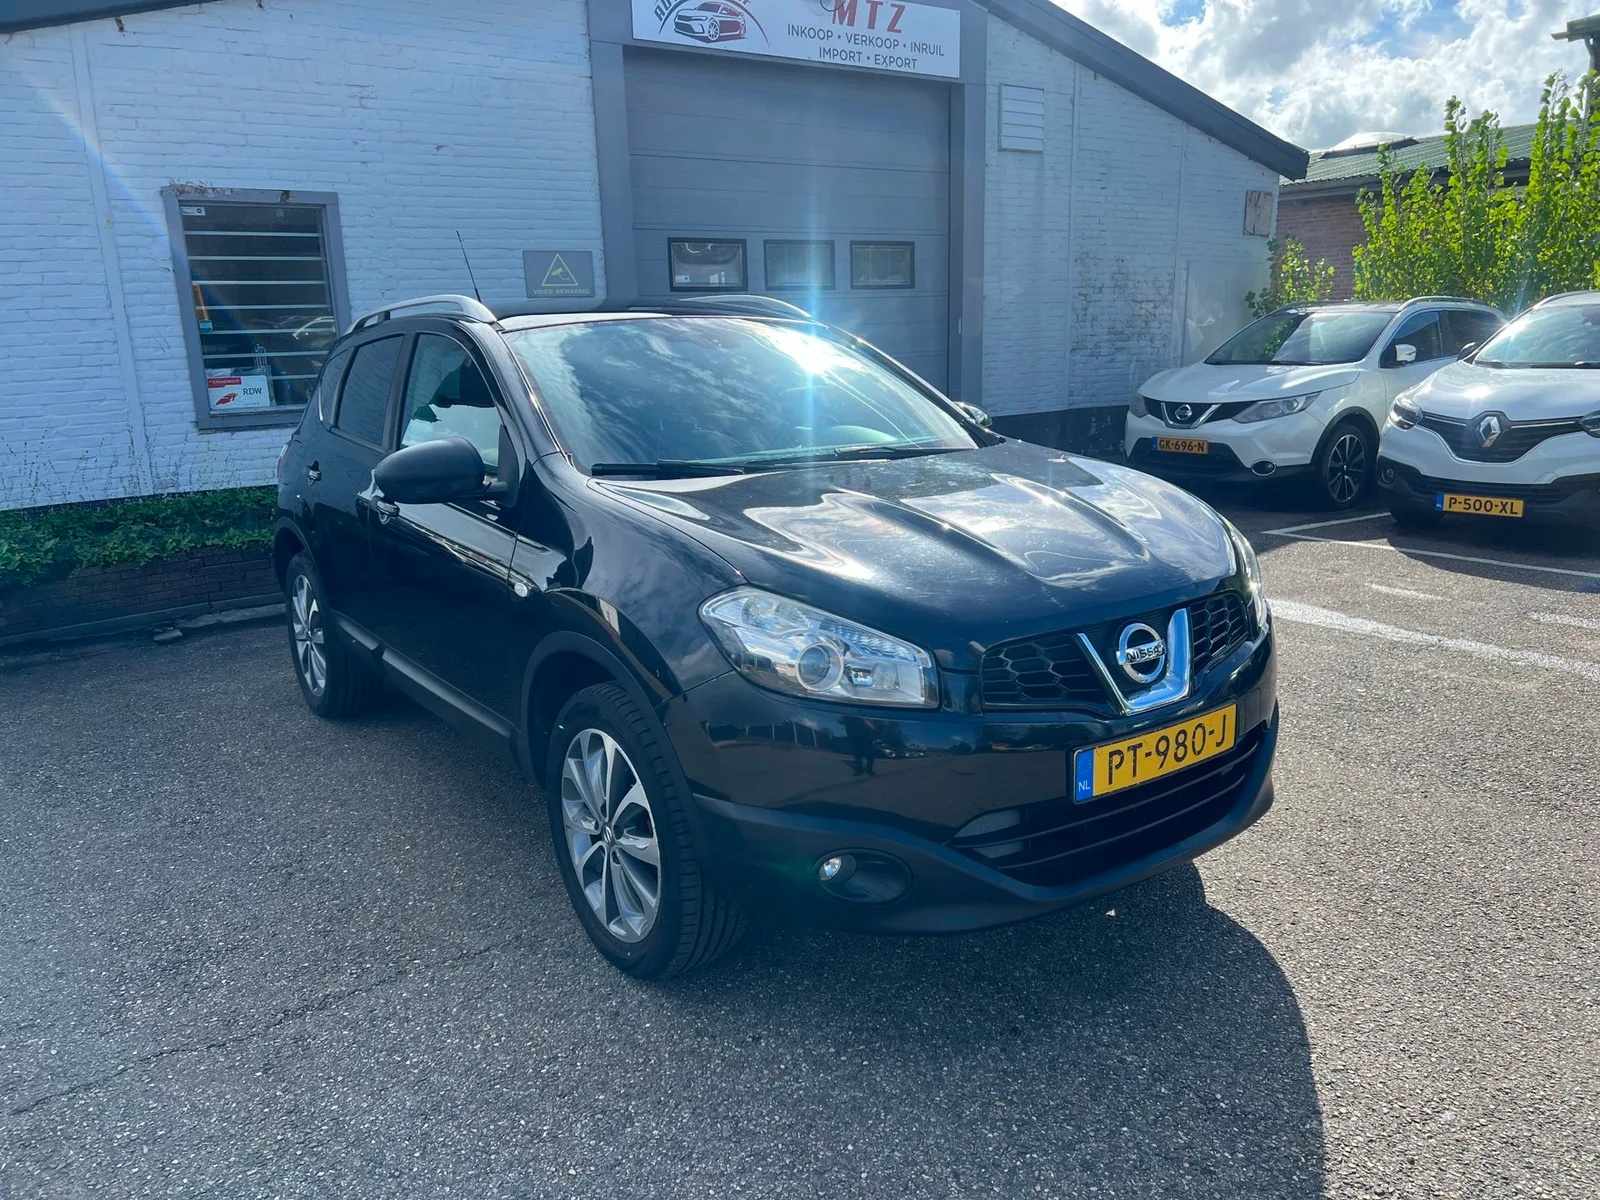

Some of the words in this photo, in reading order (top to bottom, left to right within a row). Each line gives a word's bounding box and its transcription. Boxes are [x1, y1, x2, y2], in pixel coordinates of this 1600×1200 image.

[831, 0, 906, 34] MTZ
[787, 24, 834, 41] INKOOP
[845, 32, 900, 50] VERKOOP
[910, 41, 945, 56] INRUIL
[819, 47, 863, 63] IMPORT
[874, 54, 918, 69] EXPORT
[242, 387, 262, 395] RDW
[1158, 439, 1204, 452] GK-696-N
[1448, 497, 1518, 515] P-500-XL
[1108, 713, 1227, 786] PT-980-J
[1078, 780, 1091, 792] NL
